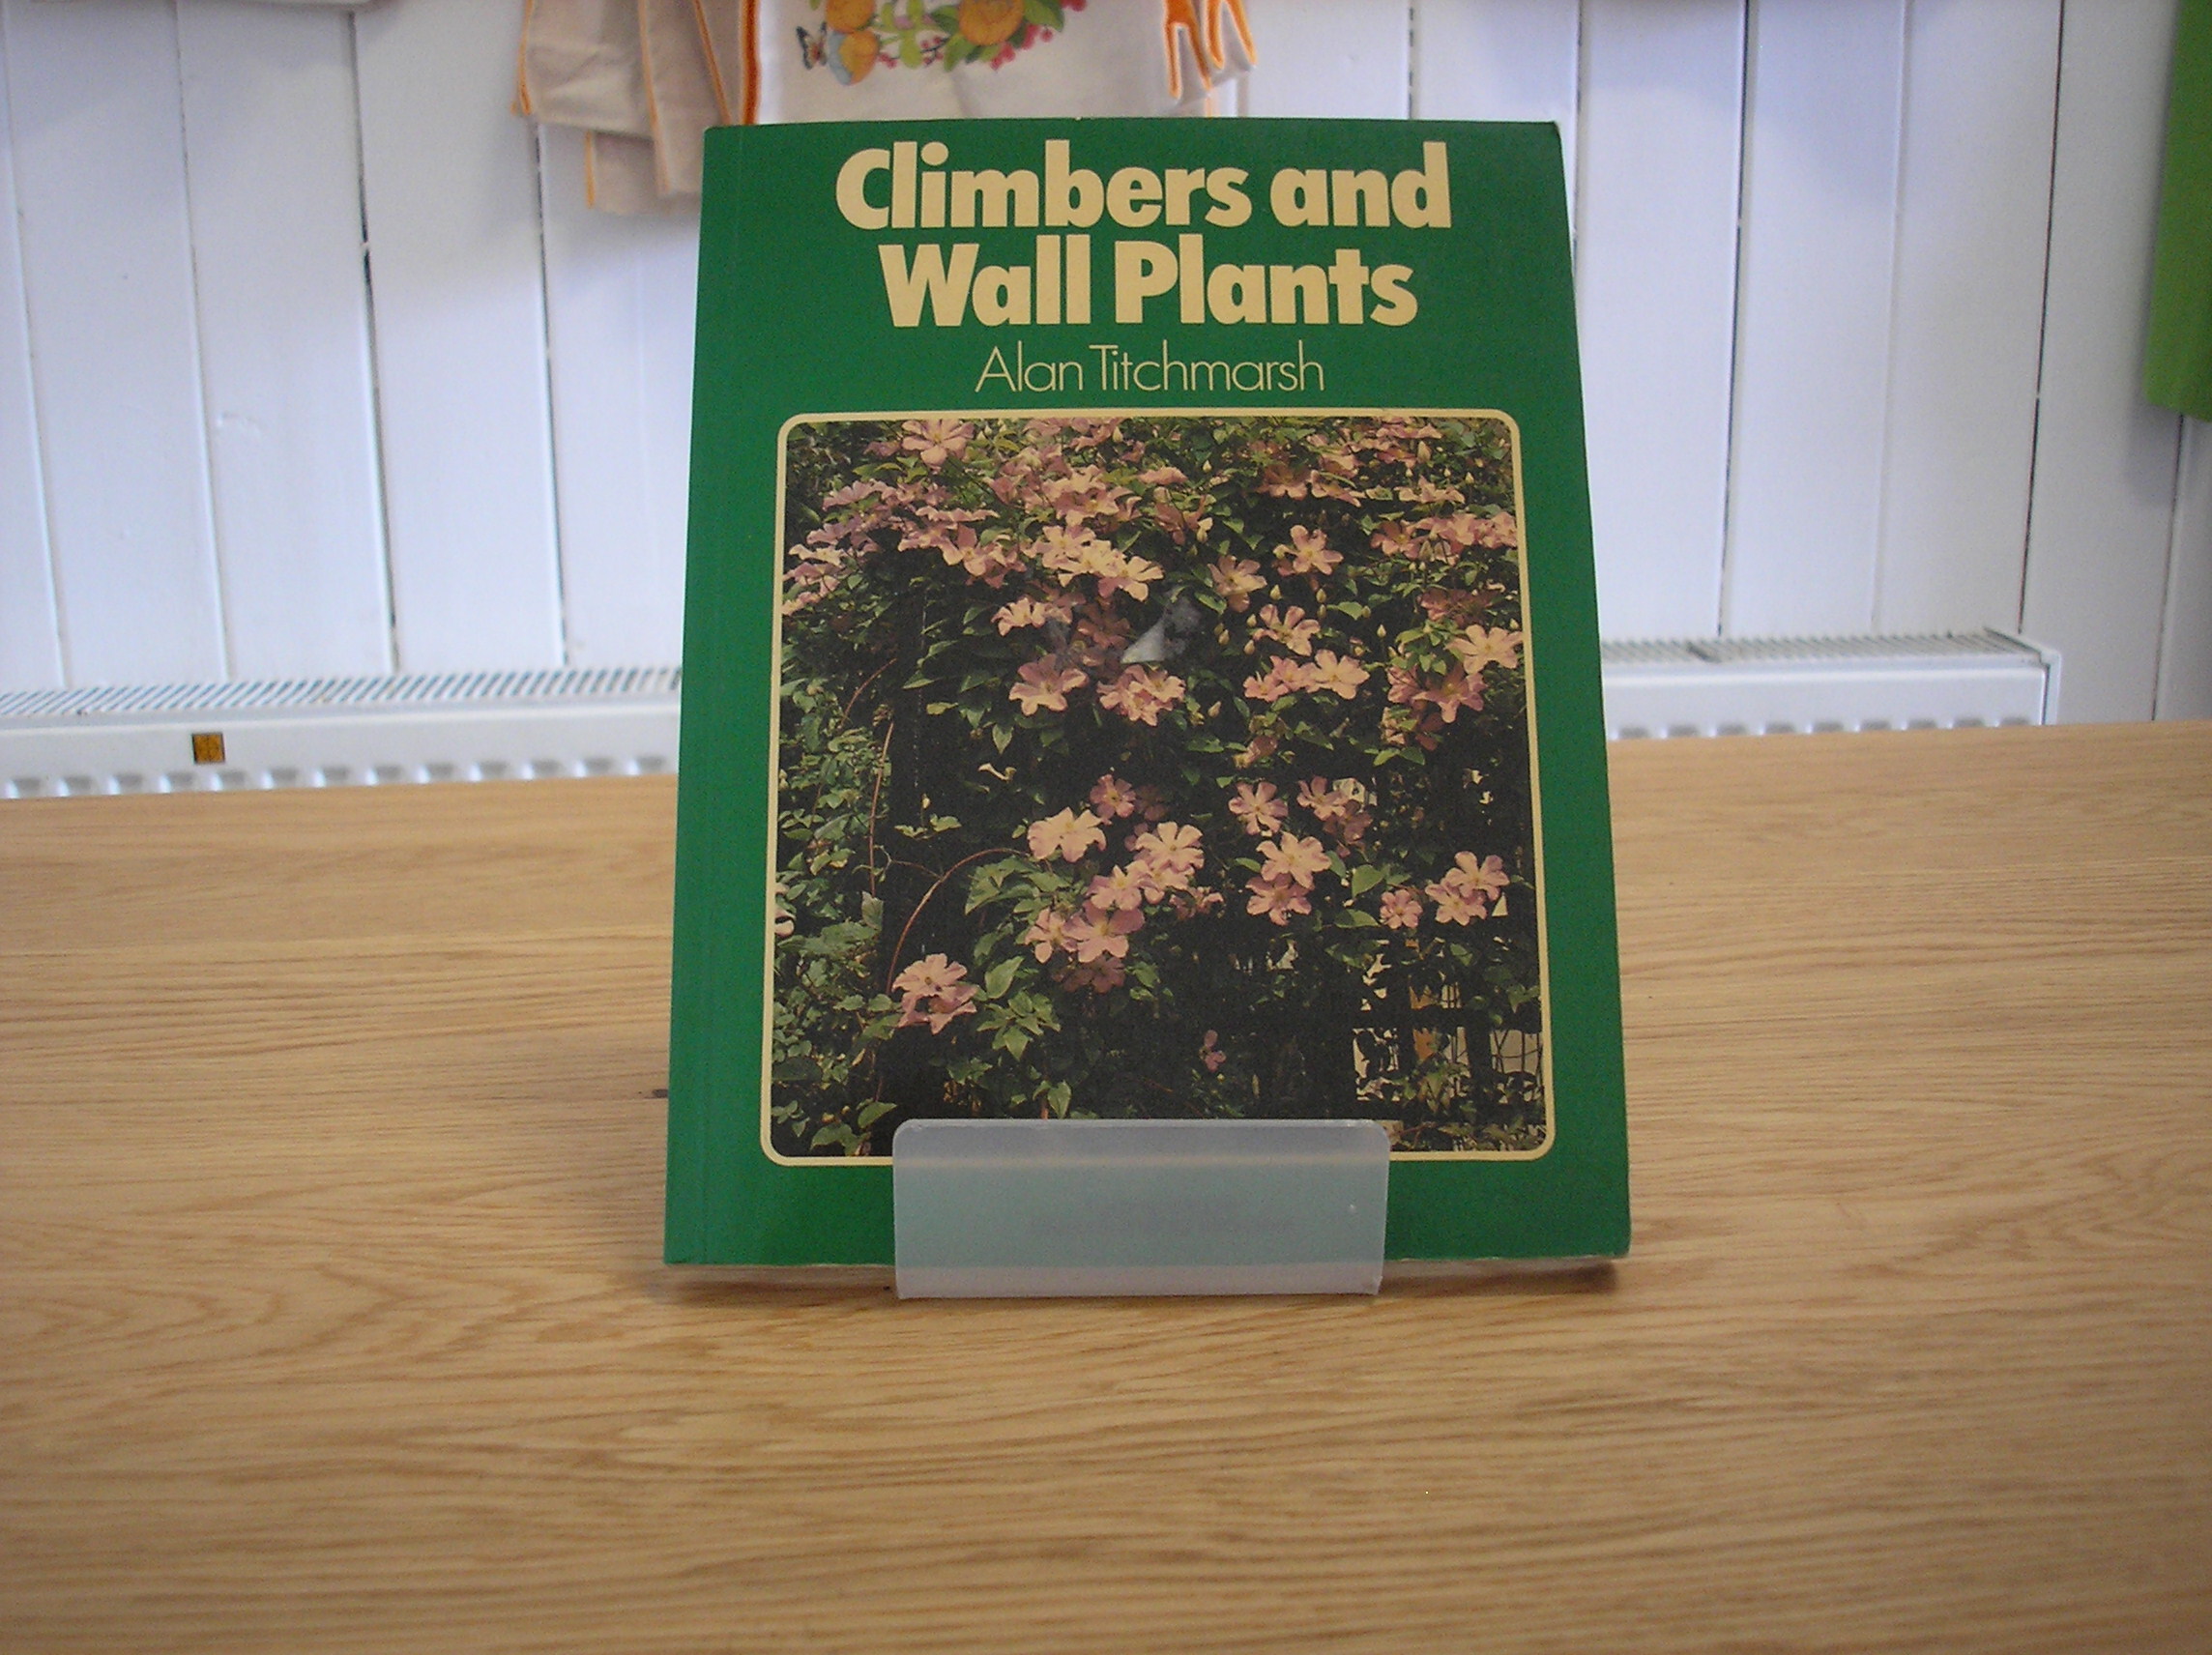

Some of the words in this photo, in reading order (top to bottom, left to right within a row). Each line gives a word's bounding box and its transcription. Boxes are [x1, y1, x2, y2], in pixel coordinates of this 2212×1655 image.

[835, 138, 1253, 230] Climbers
[1269, 140, 1452, 229] and
[878, 234, 1091, 328] Wall
[1114, 233, 1418, 327] Plants
[975, 339, 1084, 392] Alan
[1089, 339, 1325, 392] Titchmarsh
